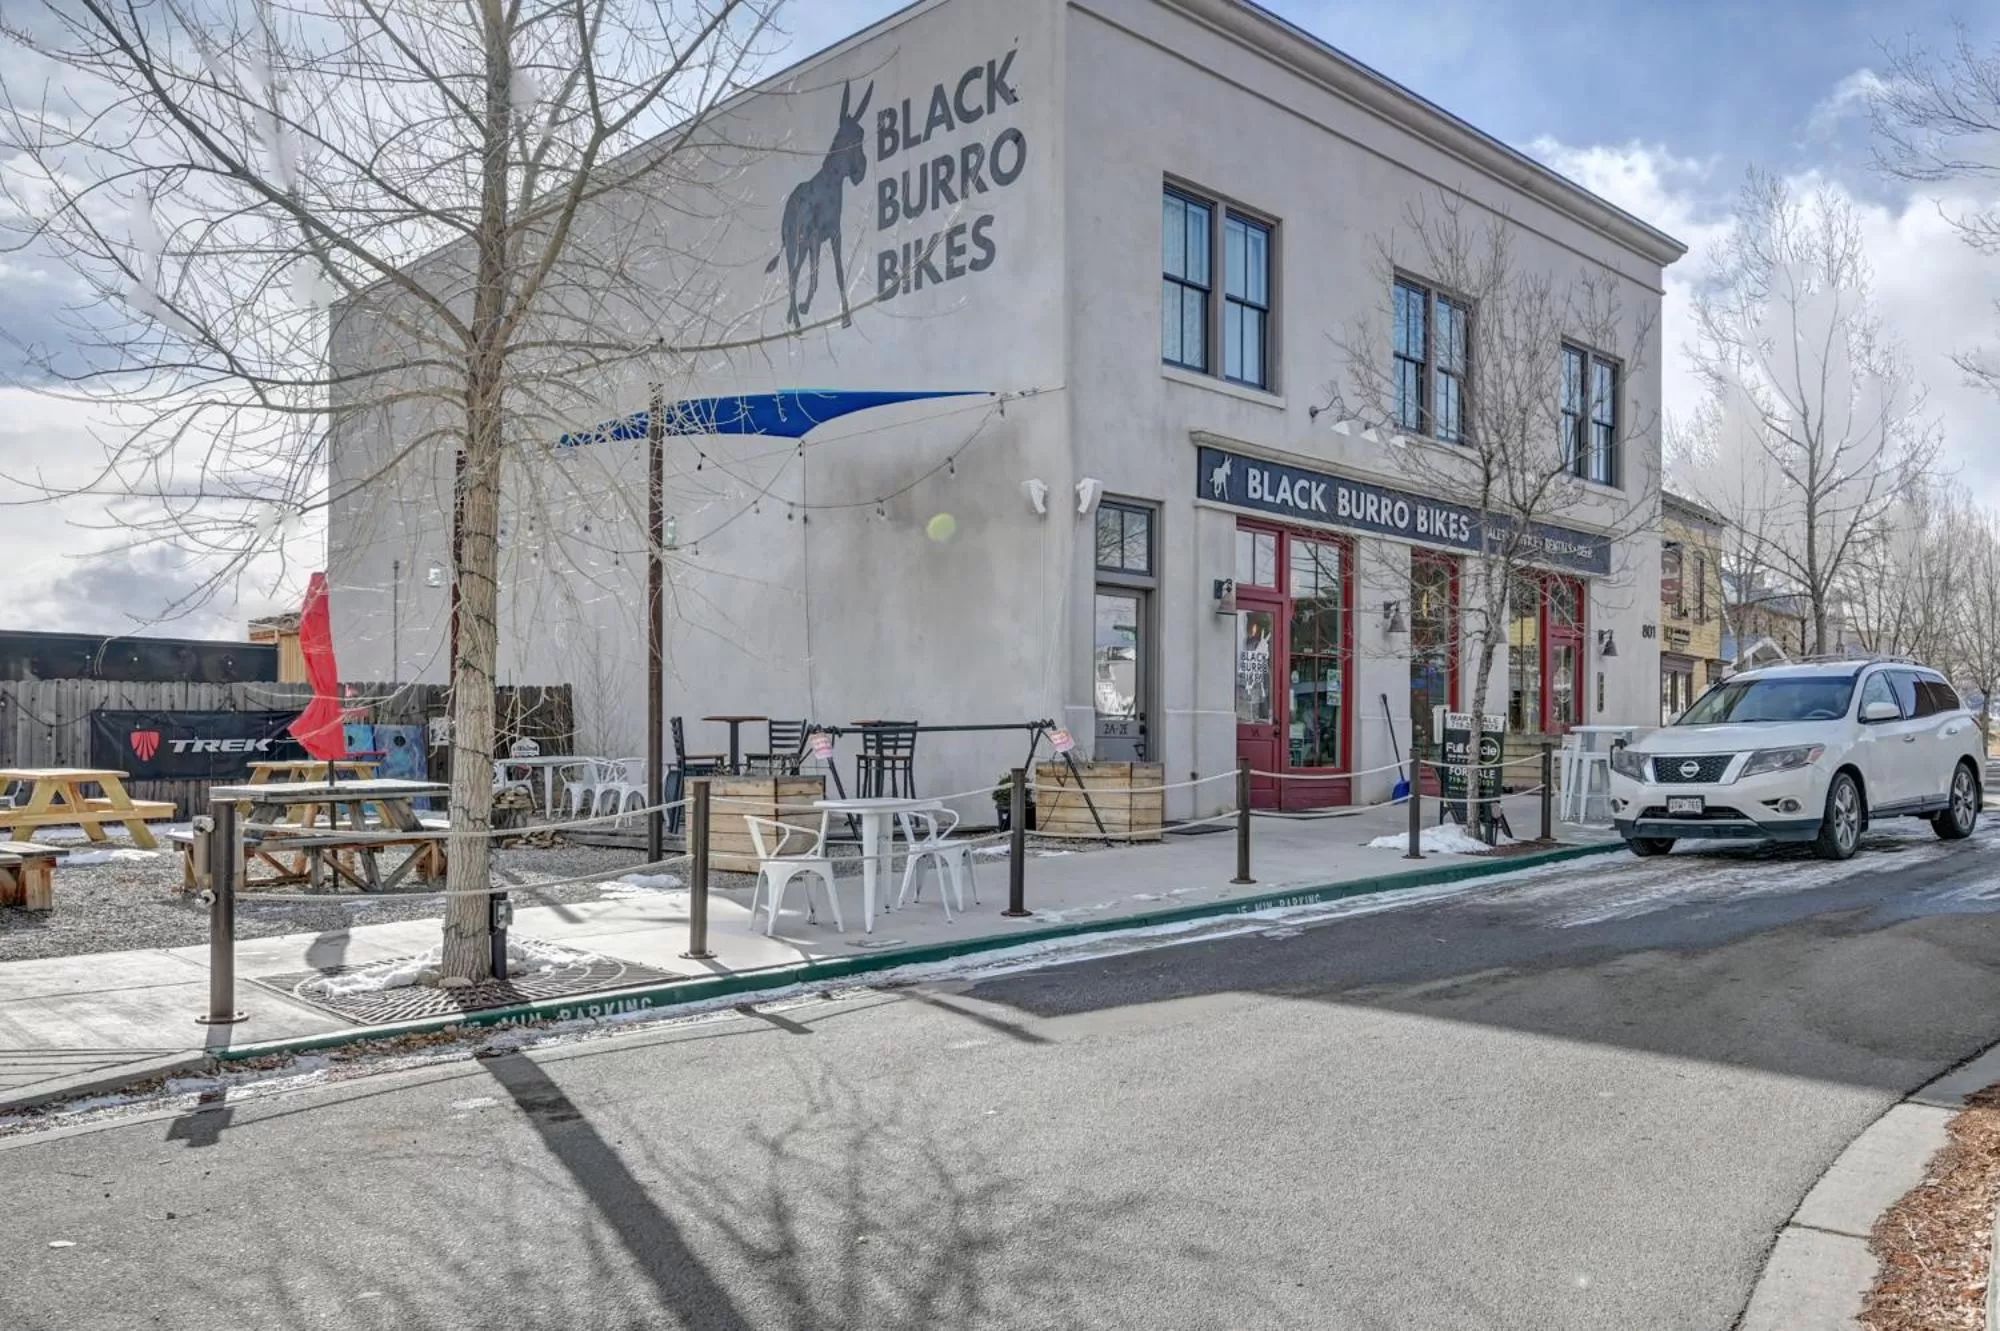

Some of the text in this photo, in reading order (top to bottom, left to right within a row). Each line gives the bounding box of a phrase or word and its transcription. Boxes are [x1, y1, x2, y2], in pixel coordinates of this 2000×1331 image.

[877, 49, 1020, 162] BLACK
[877, 127, 1027, 231] BURRO
[877, 214, 996, 302] BIKES
[1247, 468, 1471, 543] BLACK BURRO BIKES
[1642, 624, 1656, 639] 801
[168, 738, 275, 753] TREK
[1446, 742, 1497, 756] Full Ccle
[1474, 769, 1495, 779] ALE
[559, 997, 652, 1020] PARKING
